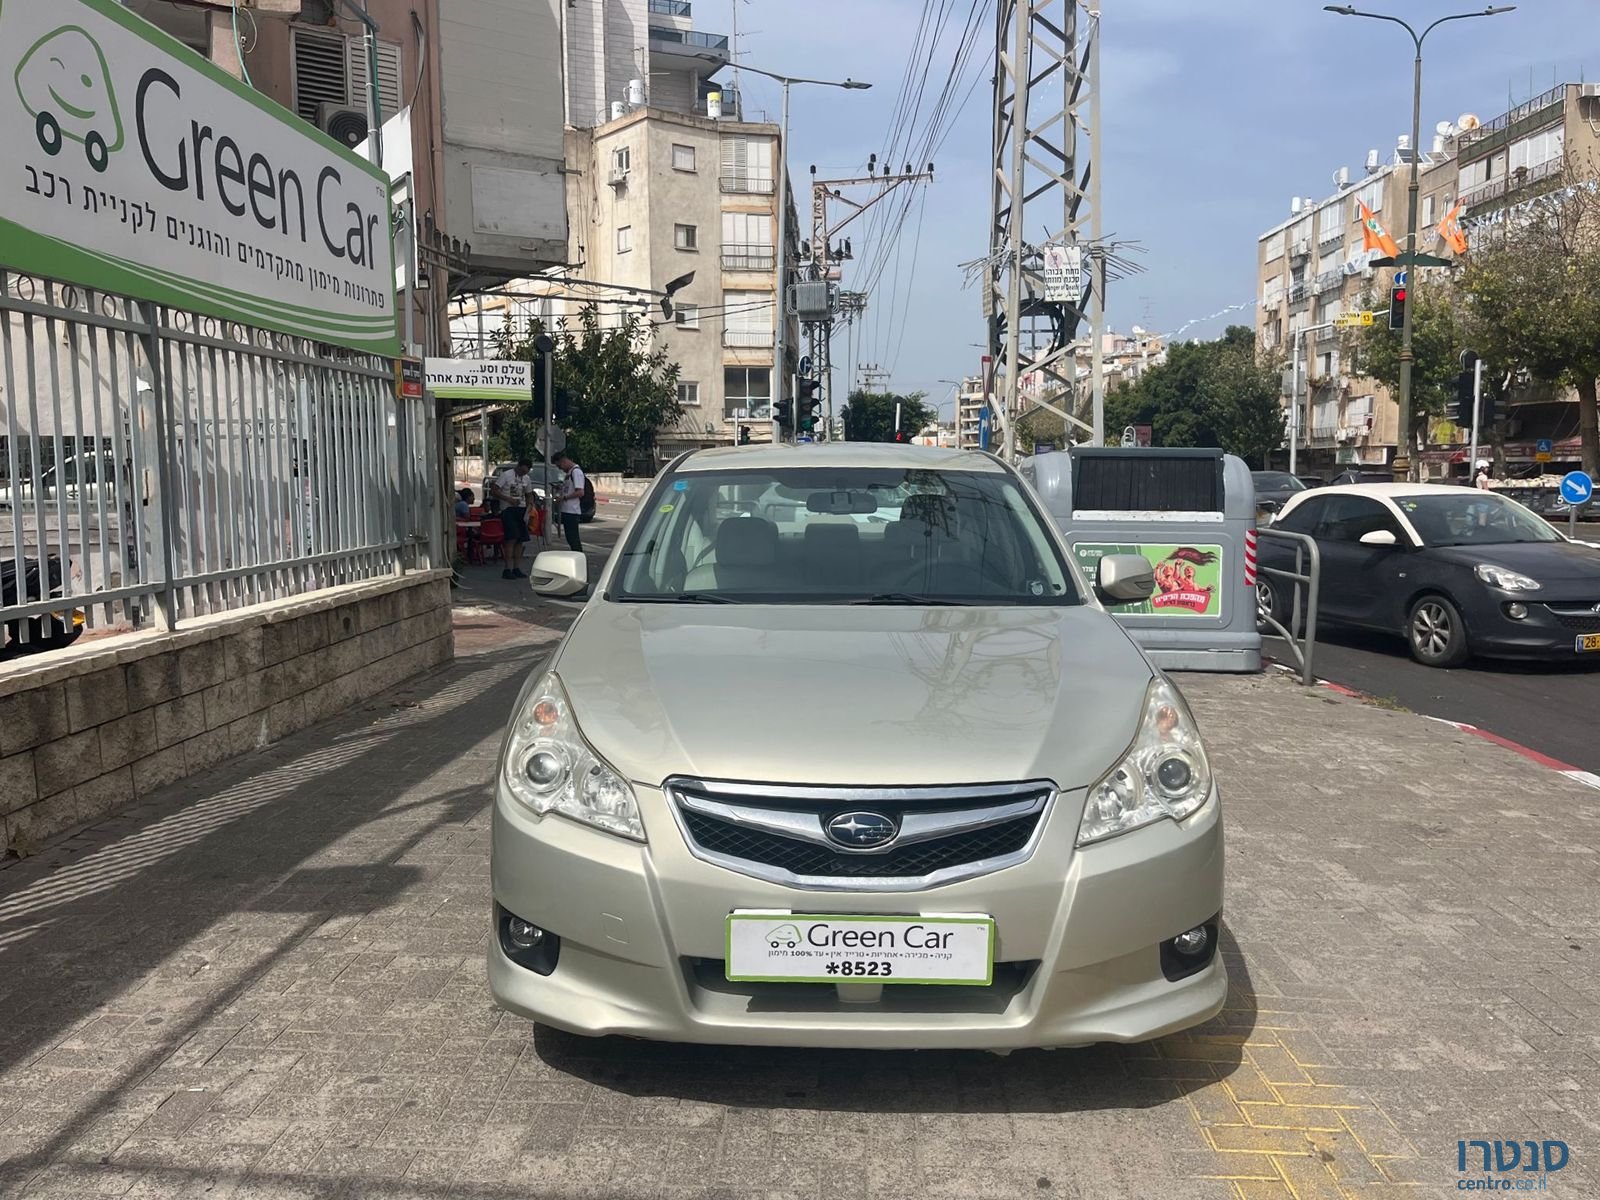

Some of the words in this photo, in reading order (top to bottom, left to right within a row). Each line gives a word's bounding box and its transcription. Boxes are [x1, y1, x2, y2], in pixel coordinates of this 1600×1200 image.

[136, 68, 307, 243] Green
[317, 165, 379, 270] Car
[25, 164, 72, 205] רכב
[83, 185, 156, 234] לקניית
[166, 215, 230, 258] והוגנים
[238, 241, 304, 282] מתקדמים
[308, 267, 340, 294] מימון
[344, 279, 385, 309] פתרונות
[456, 374, 478, 386] קצת
[469, 364, 498, 373] וסע...
[482, 376, 493, 385] זה
[497, 375, 525, 386] אצלנו
[502, 364, 525, 374] שלם
[808, 923, 895, 948] Green
[904, 926, 954, 949] Car
